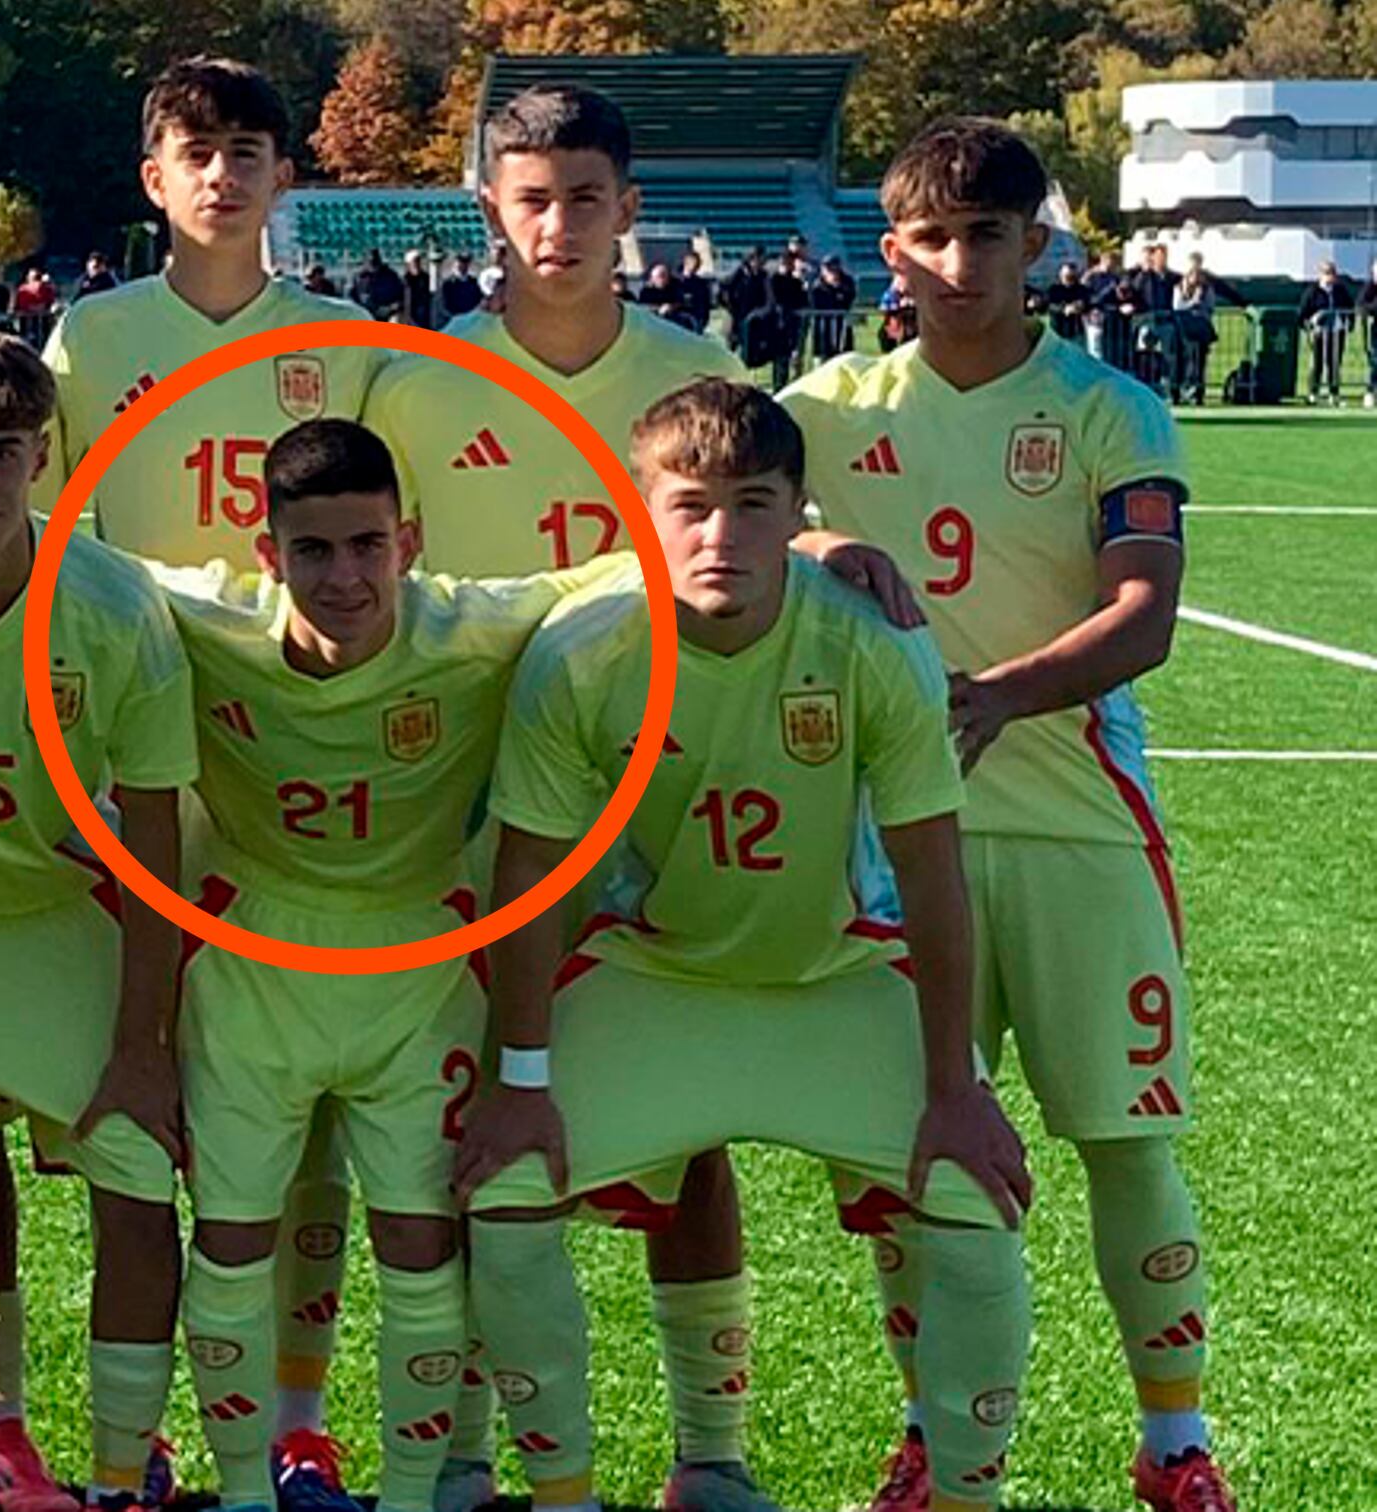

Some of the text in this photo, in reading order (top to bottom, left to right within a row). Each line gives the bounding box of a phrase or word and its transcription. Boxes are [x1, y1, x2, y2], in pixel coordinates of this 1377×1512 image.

[182, 434, 268, 529] 15
[538, 501, 620, 570] 17
[925, 506, 976, 597] 9
[278, 780, 371, 839] 21
[692, 788, 784, 870] 12
[1126, 974, 1173, 1066] 9
